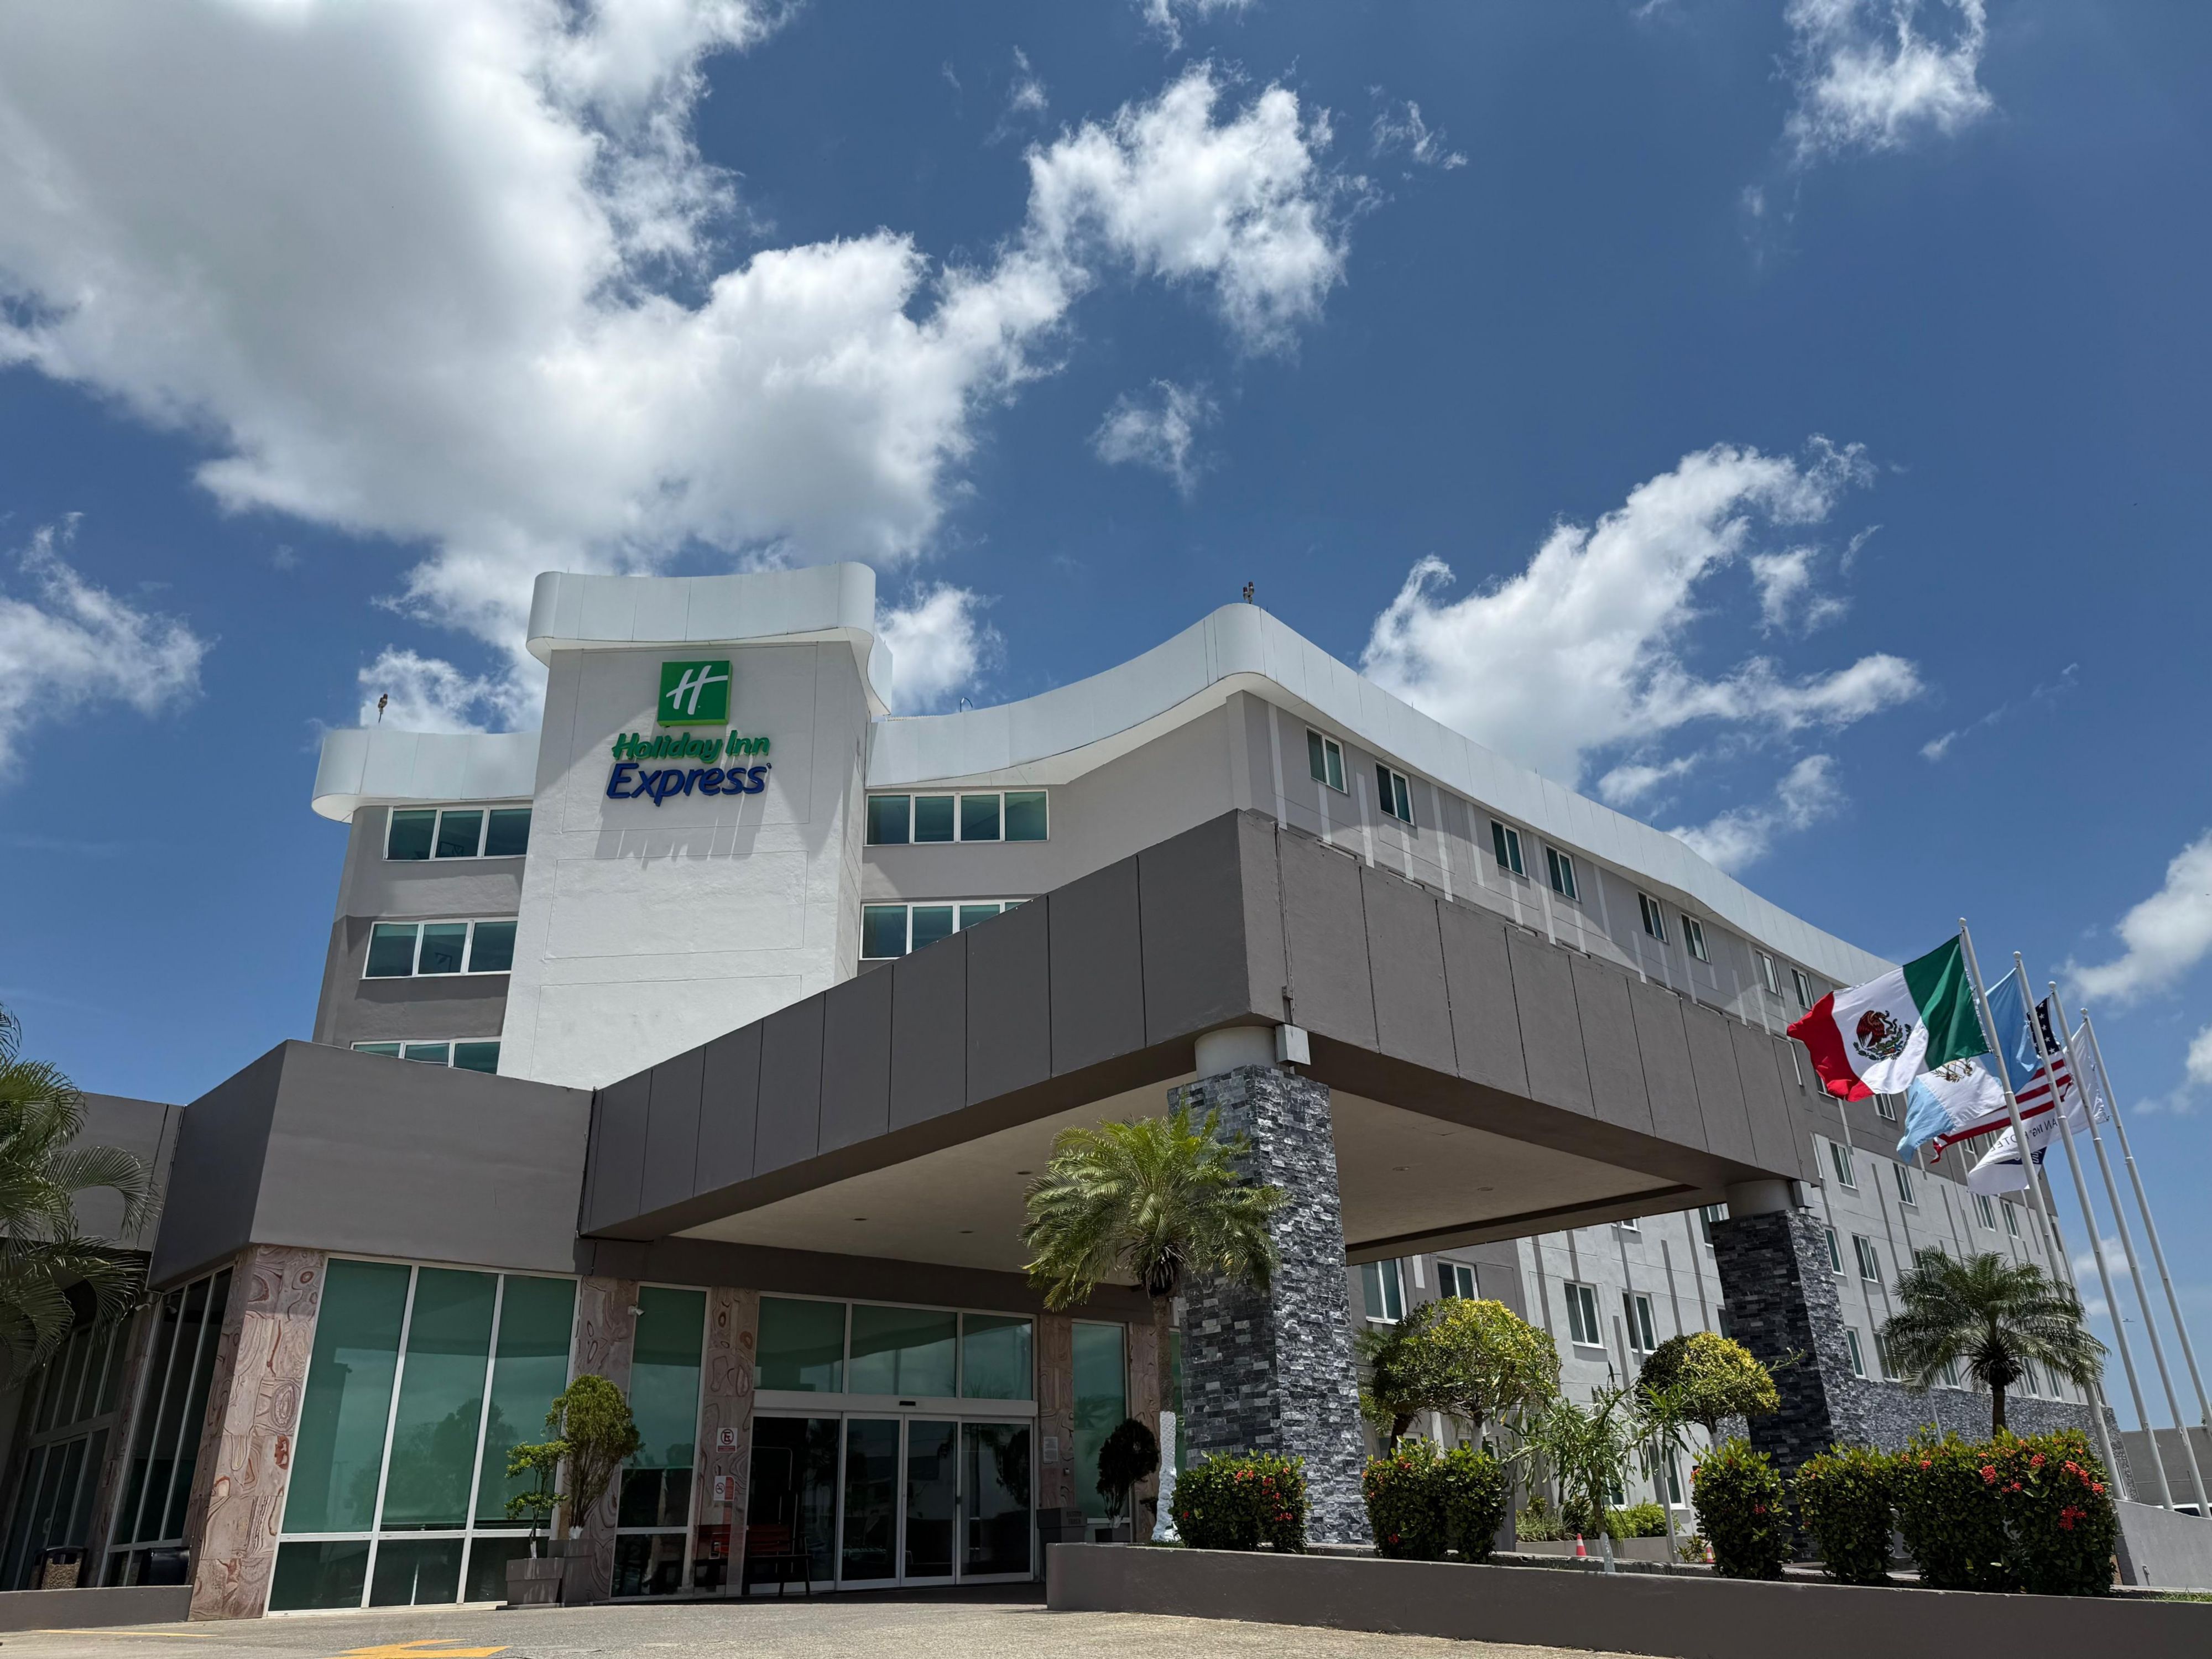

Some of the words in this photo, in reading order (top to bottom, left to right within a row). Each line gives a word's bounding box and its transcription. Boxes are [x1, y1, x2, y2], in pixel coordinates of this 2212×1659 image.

[612, 733, 723, 763] Holiday
[726, 730, 770, 756] Inn
[607, 763, 768, 807] Express
